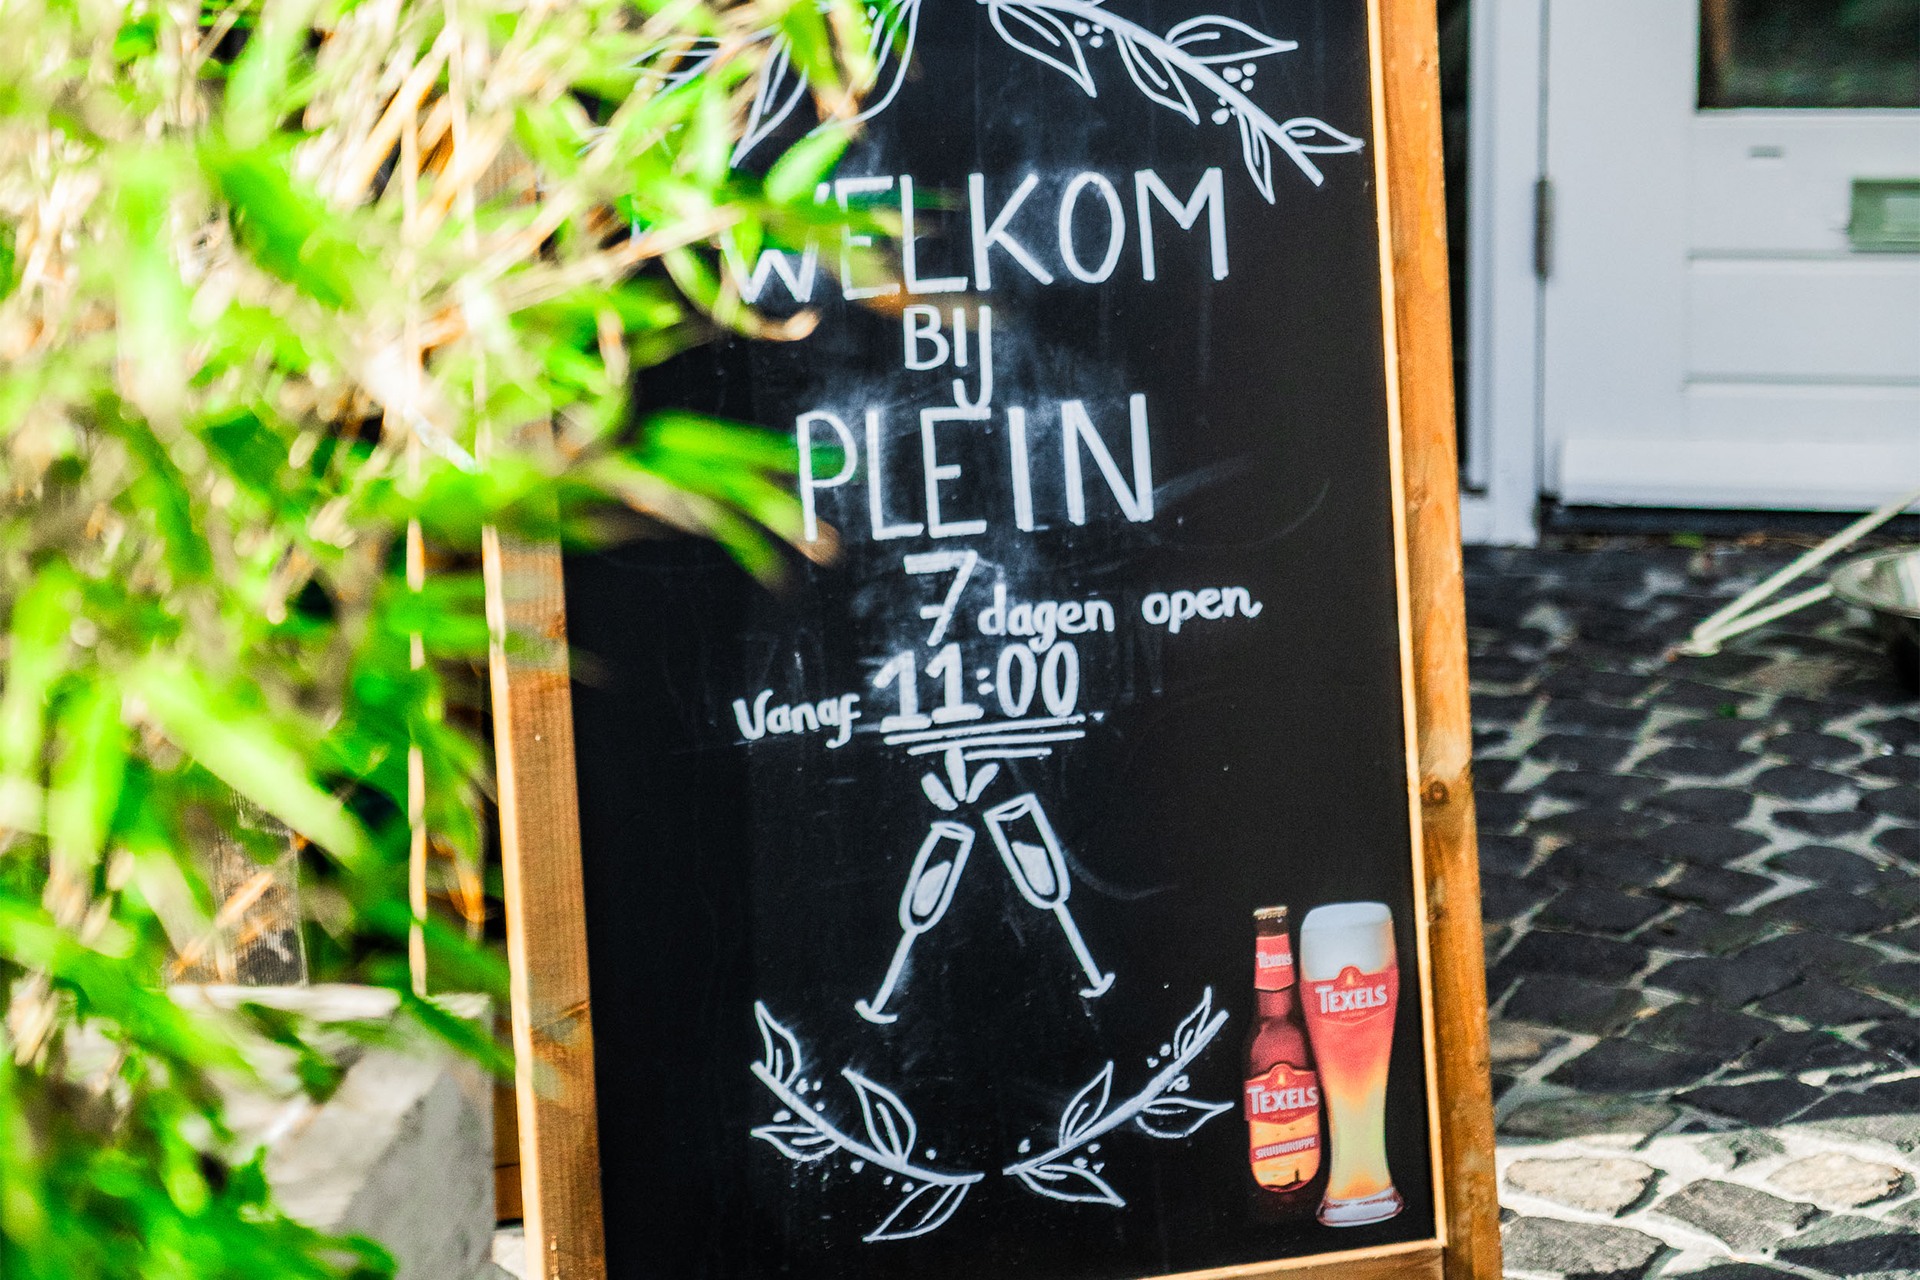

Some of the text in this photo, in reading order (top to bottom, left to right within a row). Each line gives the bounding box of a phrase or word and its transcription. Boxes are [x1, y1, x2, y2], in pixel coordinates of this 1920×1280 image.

[719, 168, 1228, 305] WELKOM
[904, 304, 993, 409] BIJ
[797, 393, 1154, 542] PLEIN
[904, 549, 1262, 653] 7 dagen open
[733, 641, 1080, 749] Vanaf 11:00
[1315, 985, 1388, 1014] TEXELS
[1247, 1085, 1319, 1114] TEXELS
